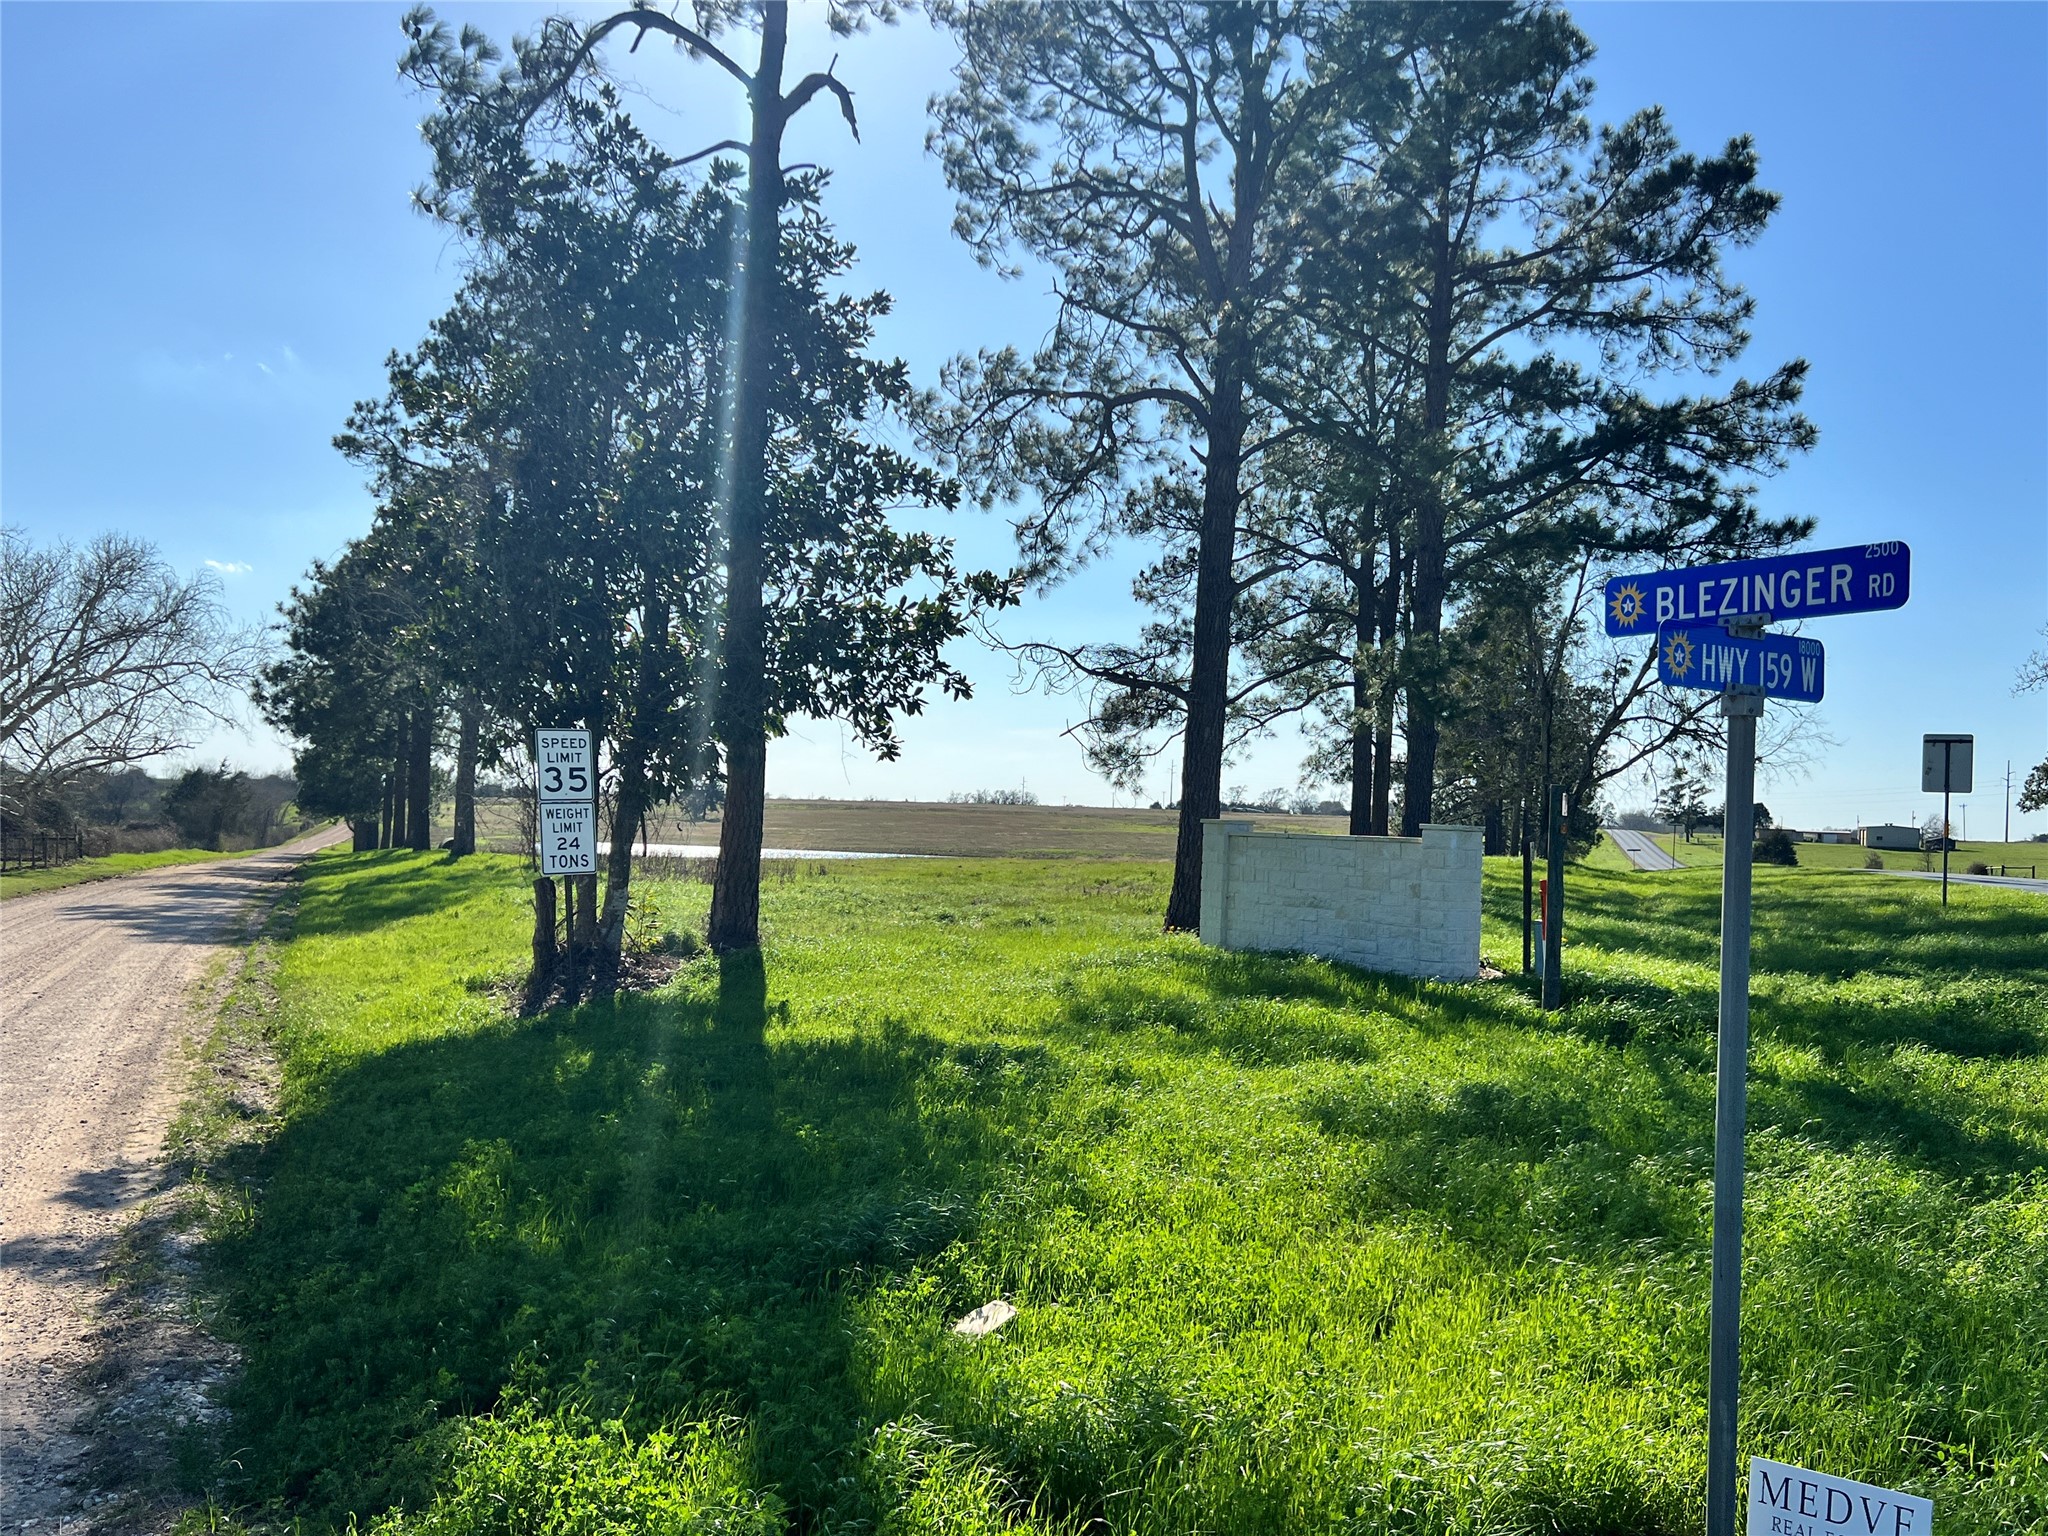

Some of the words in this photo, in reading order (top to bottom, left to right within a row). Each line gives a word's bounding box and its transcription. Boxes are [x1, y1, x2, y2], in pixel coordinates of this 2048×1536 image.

[1865, 541, 1899, 558] 2500
[1656, 564, 1853, 622] BLEZINGER
[1868, 573, 1895, 598] RD
[1701, 643, 1750, 684] HWY
[1759, 651, 1792, 689] 159
[1801, 656, 1816, 693] W
[541, 737, 587, 749] SPEED
[547, 752, 582, 763] LIMIT
[544, 766, 588, 793] 35
[545, 808, 590, 819] WEIGHT
[552, 822, 583, 833] LIMIT
[557, 837, 581, 851] 24
[550, 854, 589, 868] TONS
